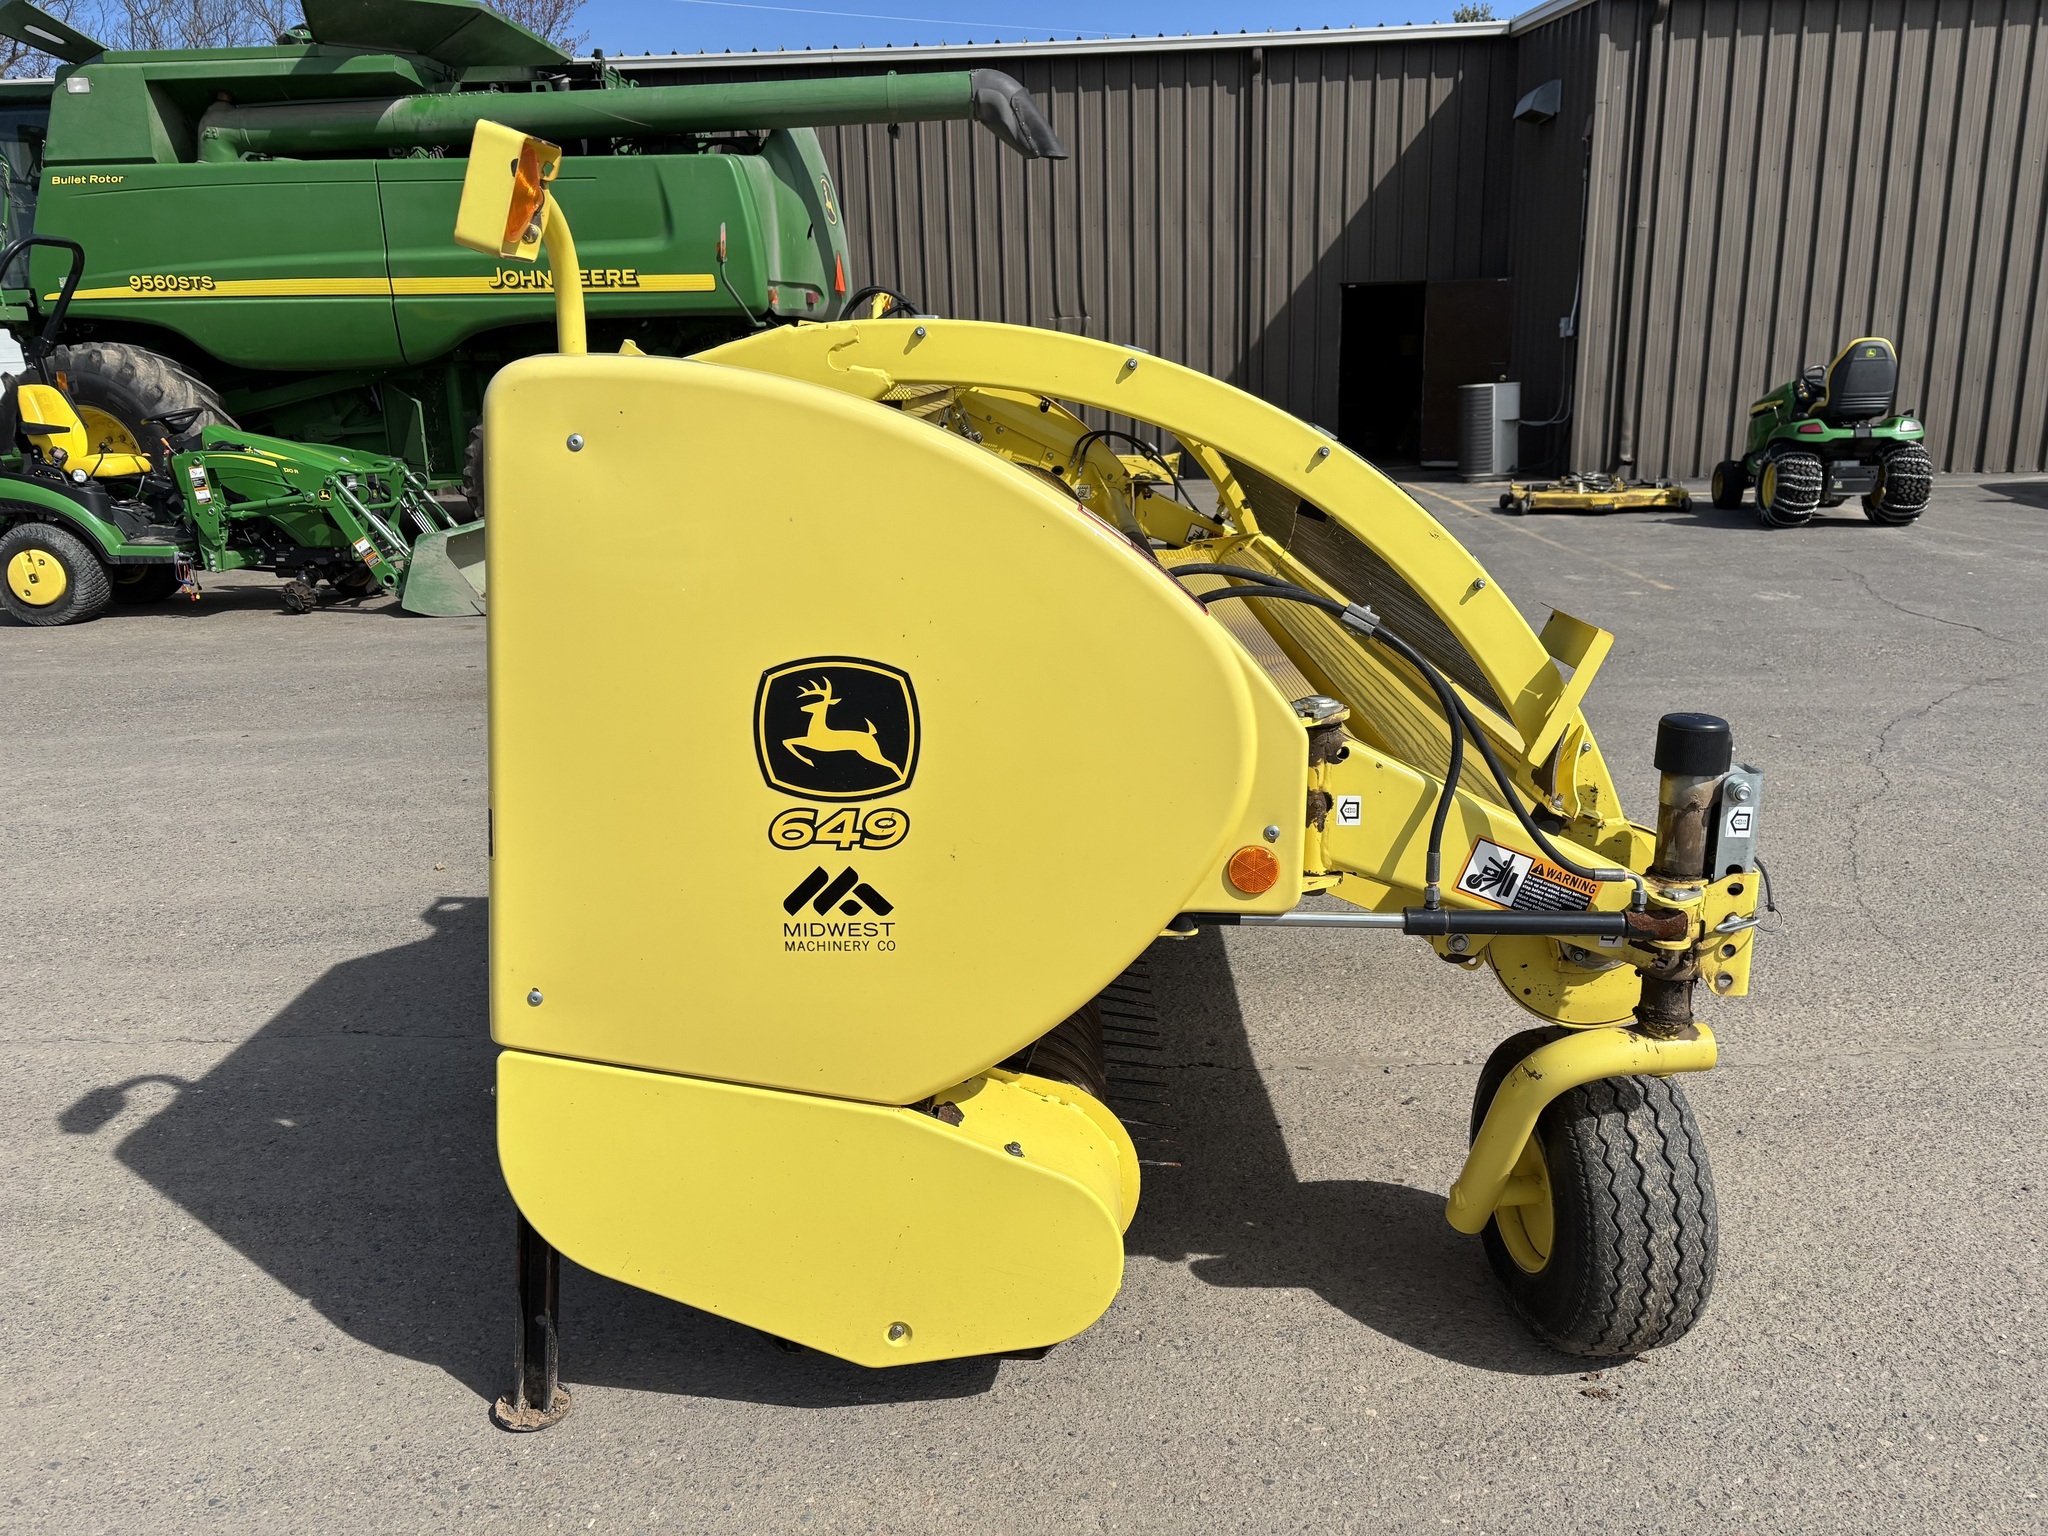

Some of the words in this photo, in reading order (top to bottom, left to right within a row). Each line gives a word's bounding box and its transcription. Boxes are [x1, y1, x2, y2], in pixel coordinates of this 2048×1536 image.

[51, 175, 86, 185] Bullet
[89, 174, 124, 184] Rotor
[128, 273, 216, 292] 9560STS
[489, 266, 554, 288] JOHN
[768, 807, 911, 851] 649
[1545, 866, 1598, 895] WARNING
[783, 922, 896, 938] MIDWEST
[784, 940, 870, 952] MACHINERY
[877, 940, 896, 952] CO
